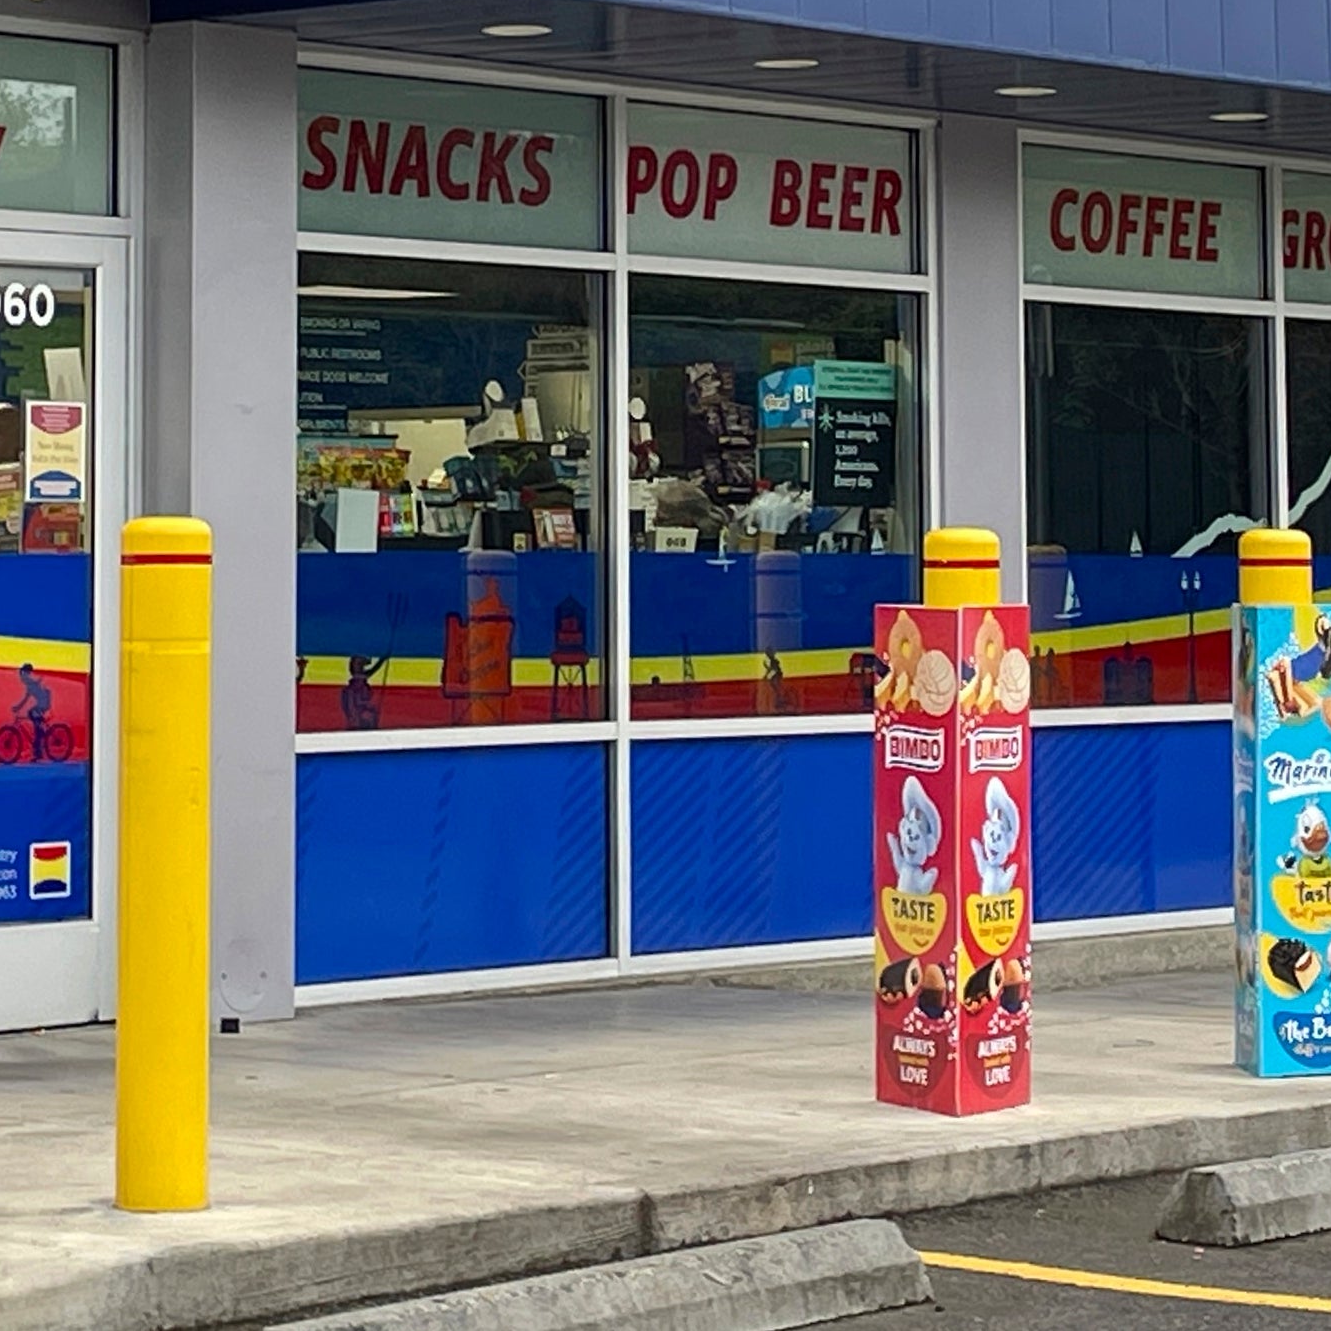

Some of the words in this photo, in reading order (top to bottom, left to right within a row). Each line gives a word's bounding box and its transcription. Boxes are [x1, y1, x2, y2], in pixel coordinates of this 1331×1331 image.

[302, 116, 554, 207] SNACKS
[627, 145, 738, 220] POP
[769, 158, 903, 237] BEER
[1050, 188, 1222, 262] COFFEE
[889, 735, 941, 761] BIMBO
[975, 736, 1019, 761] BIMBO
[891, 897, 935, 922] TASTE
[976, 899, 1015, 923] TASTE
[900, 1065, 928, 1086] LOVE
[985, 1065, 1011, 1086] LOVE
